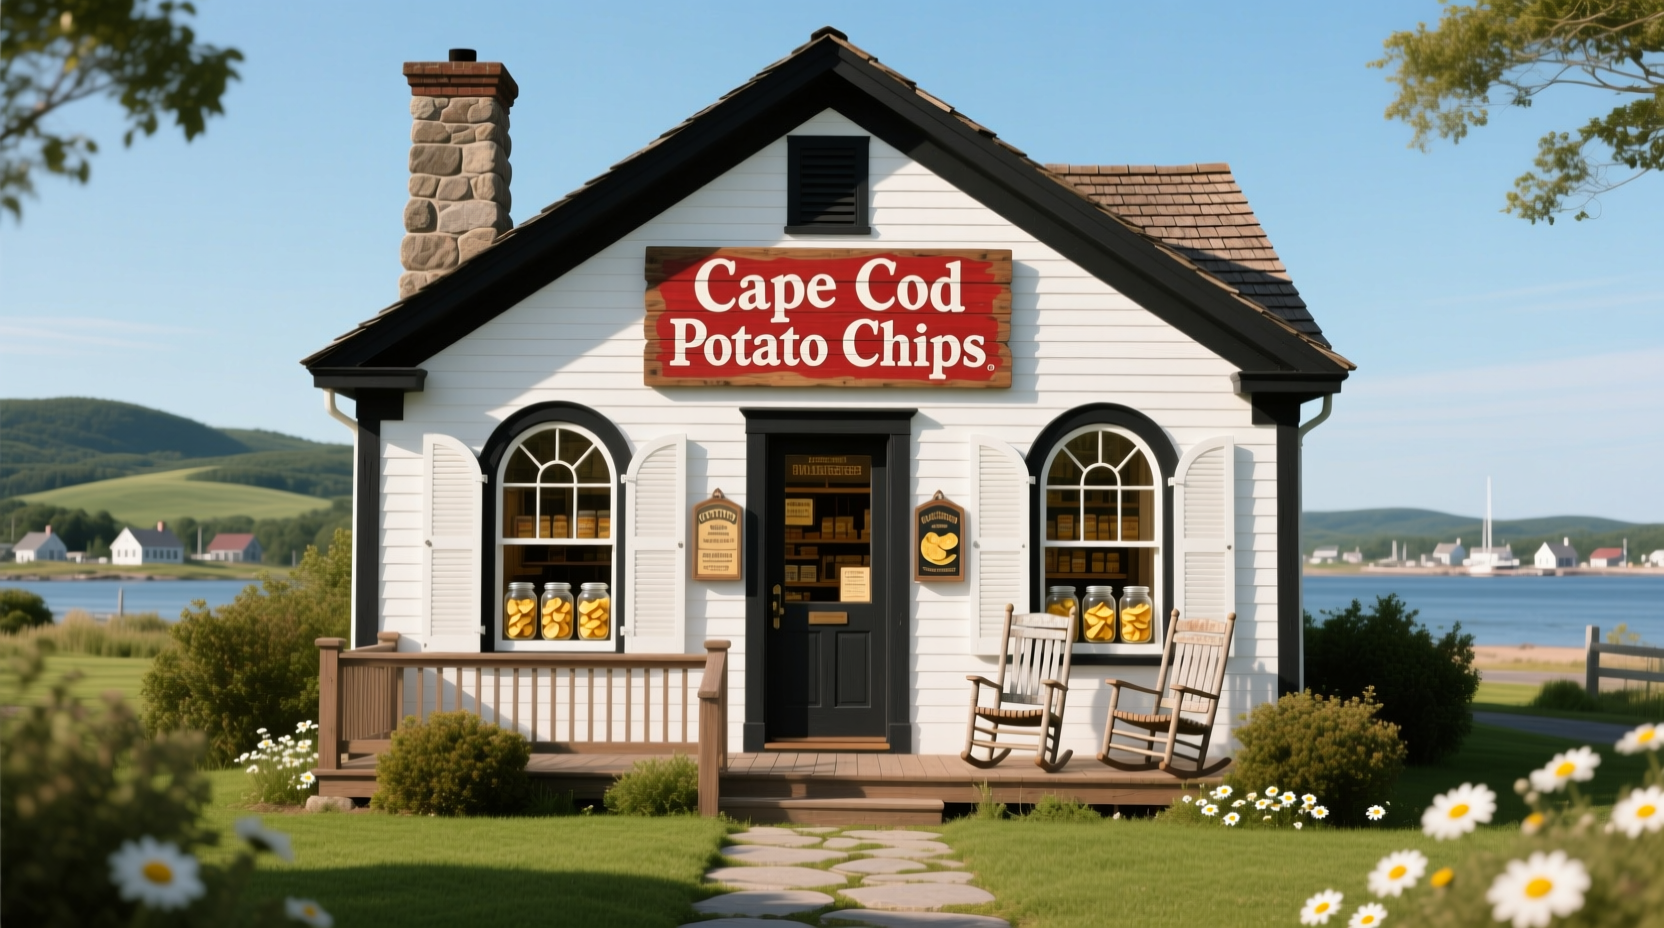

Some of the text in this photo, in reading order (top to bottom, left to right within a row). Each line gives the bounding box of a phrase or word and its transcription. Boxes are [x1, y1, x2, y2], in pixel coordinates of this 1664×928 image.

[694, 257, 966, 323] Cape Cod
[669, 317, 829, 367] Potato
